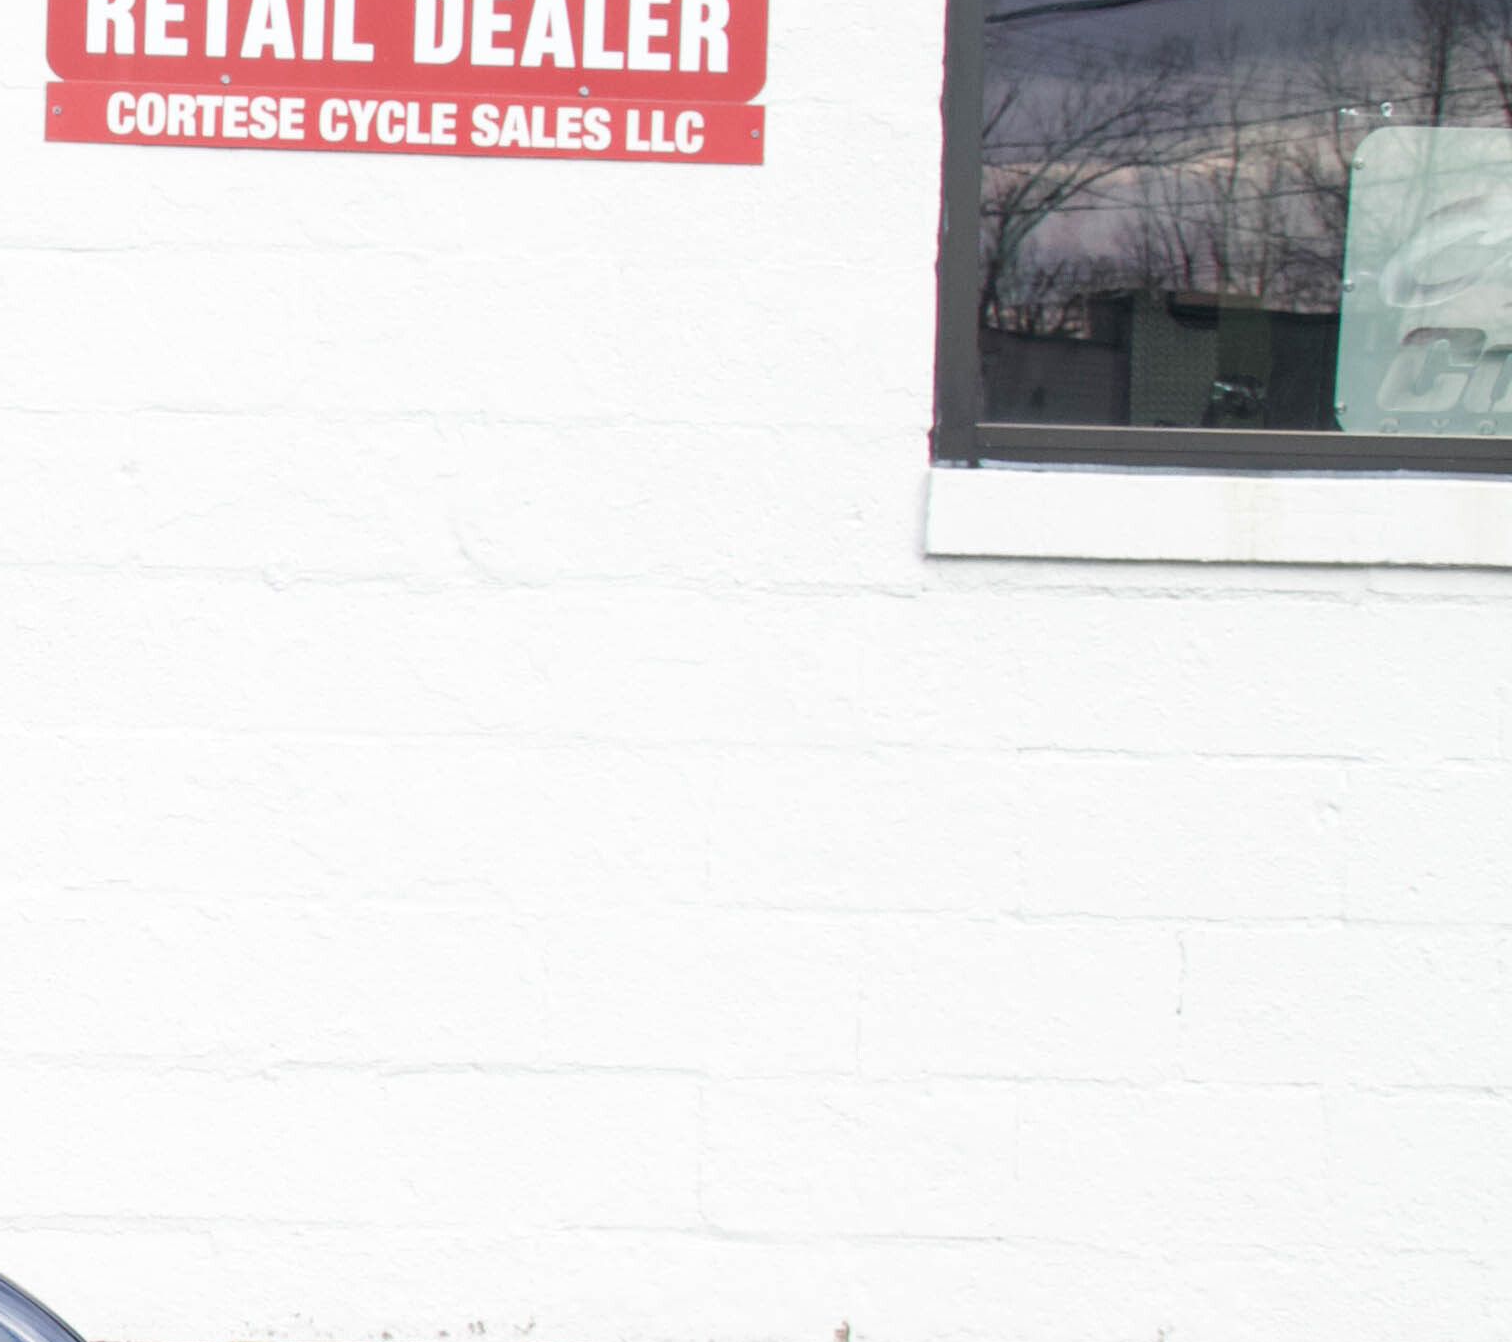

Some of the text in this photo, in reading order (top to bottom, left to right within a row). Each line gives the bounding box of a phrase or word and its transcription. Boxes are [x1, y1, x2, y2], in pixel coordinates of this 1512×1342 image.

[106, 91, 706, 154] CORTESE CYCLE SALES LLC
